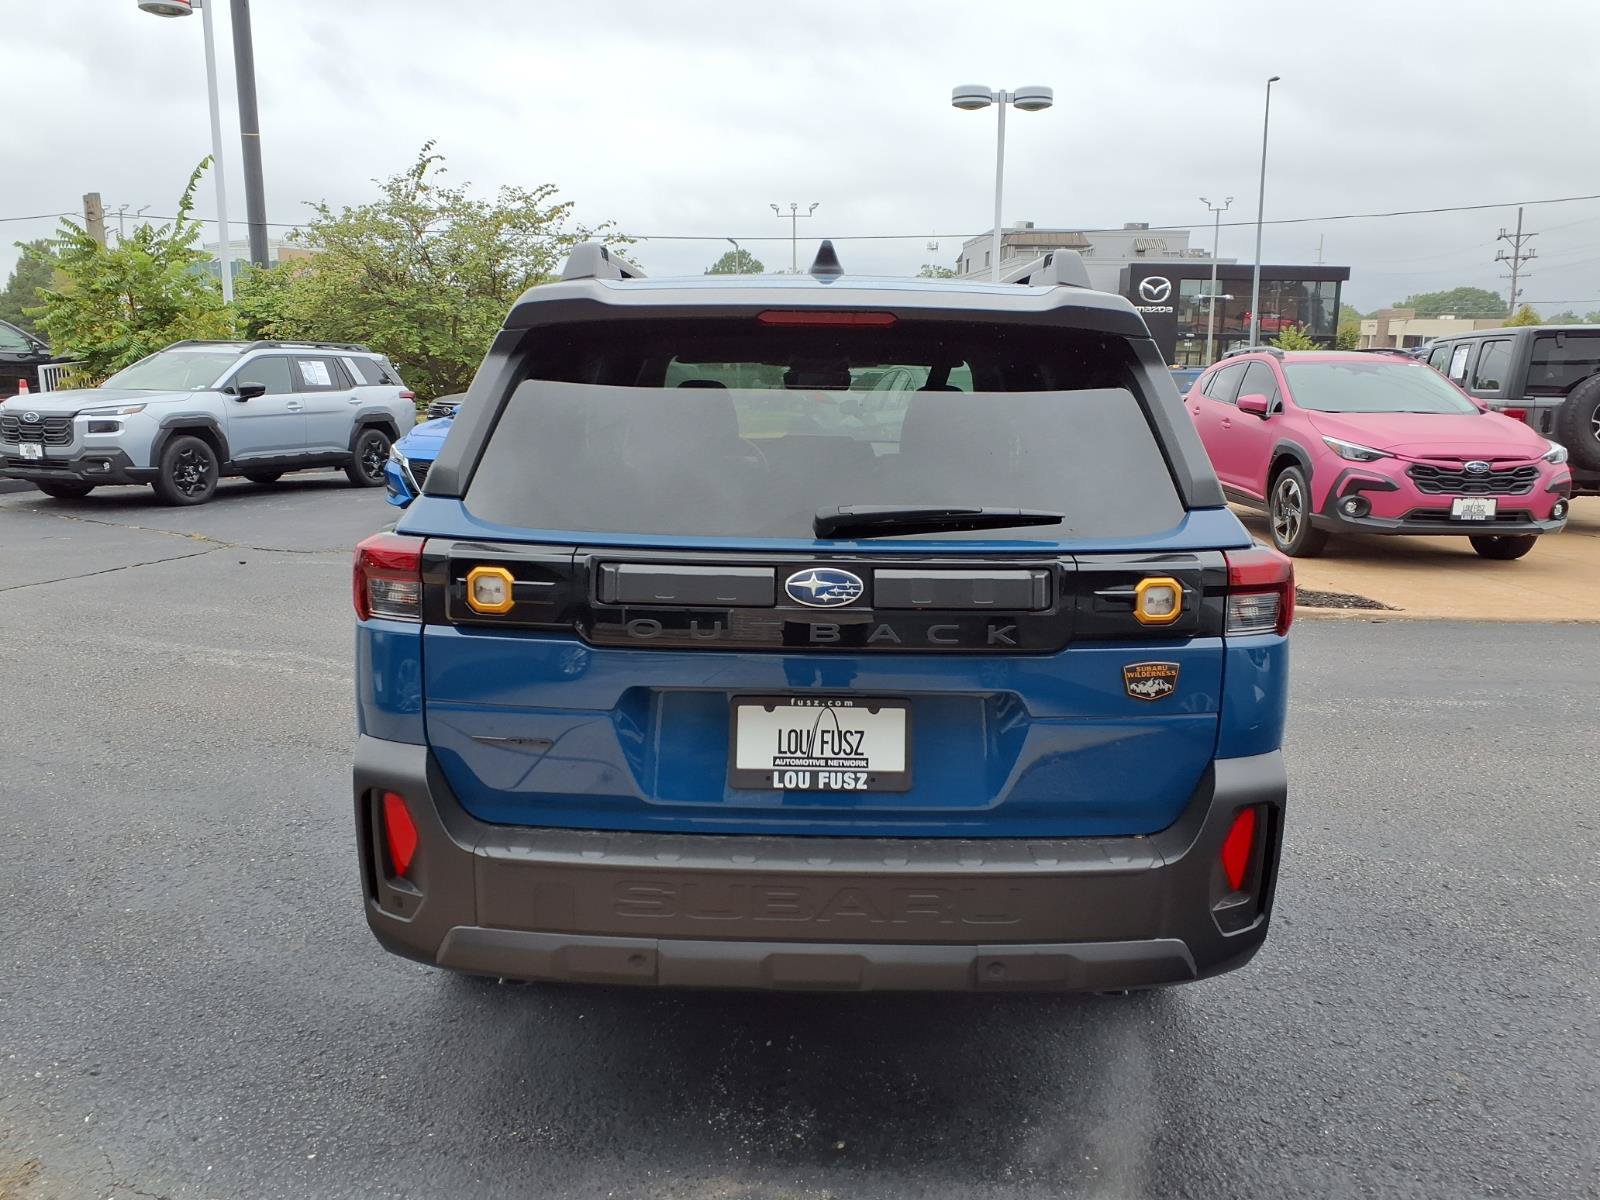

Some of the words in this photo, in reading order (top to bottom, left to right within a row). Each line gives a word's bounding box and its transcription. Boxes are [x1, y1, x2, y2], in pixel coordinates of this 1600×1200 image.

[627, 619, 1018, 645] OUBACK
[1127, 670, 1177, 678] WILDERNESS
[791, 698, 853, 706] fusz.com
[778, 729, 810, 755] LOU
[820, 730, 865, 756] FUSZ
[775, 758, 826, 767] AUTOMOTIVE
[827, 759, 868, 768] NETWORK
[773, 770, 810, 789] LOU
[818, 771, 867, 790] FUSZ
[615, 880, 1024, 926] SUBARU
